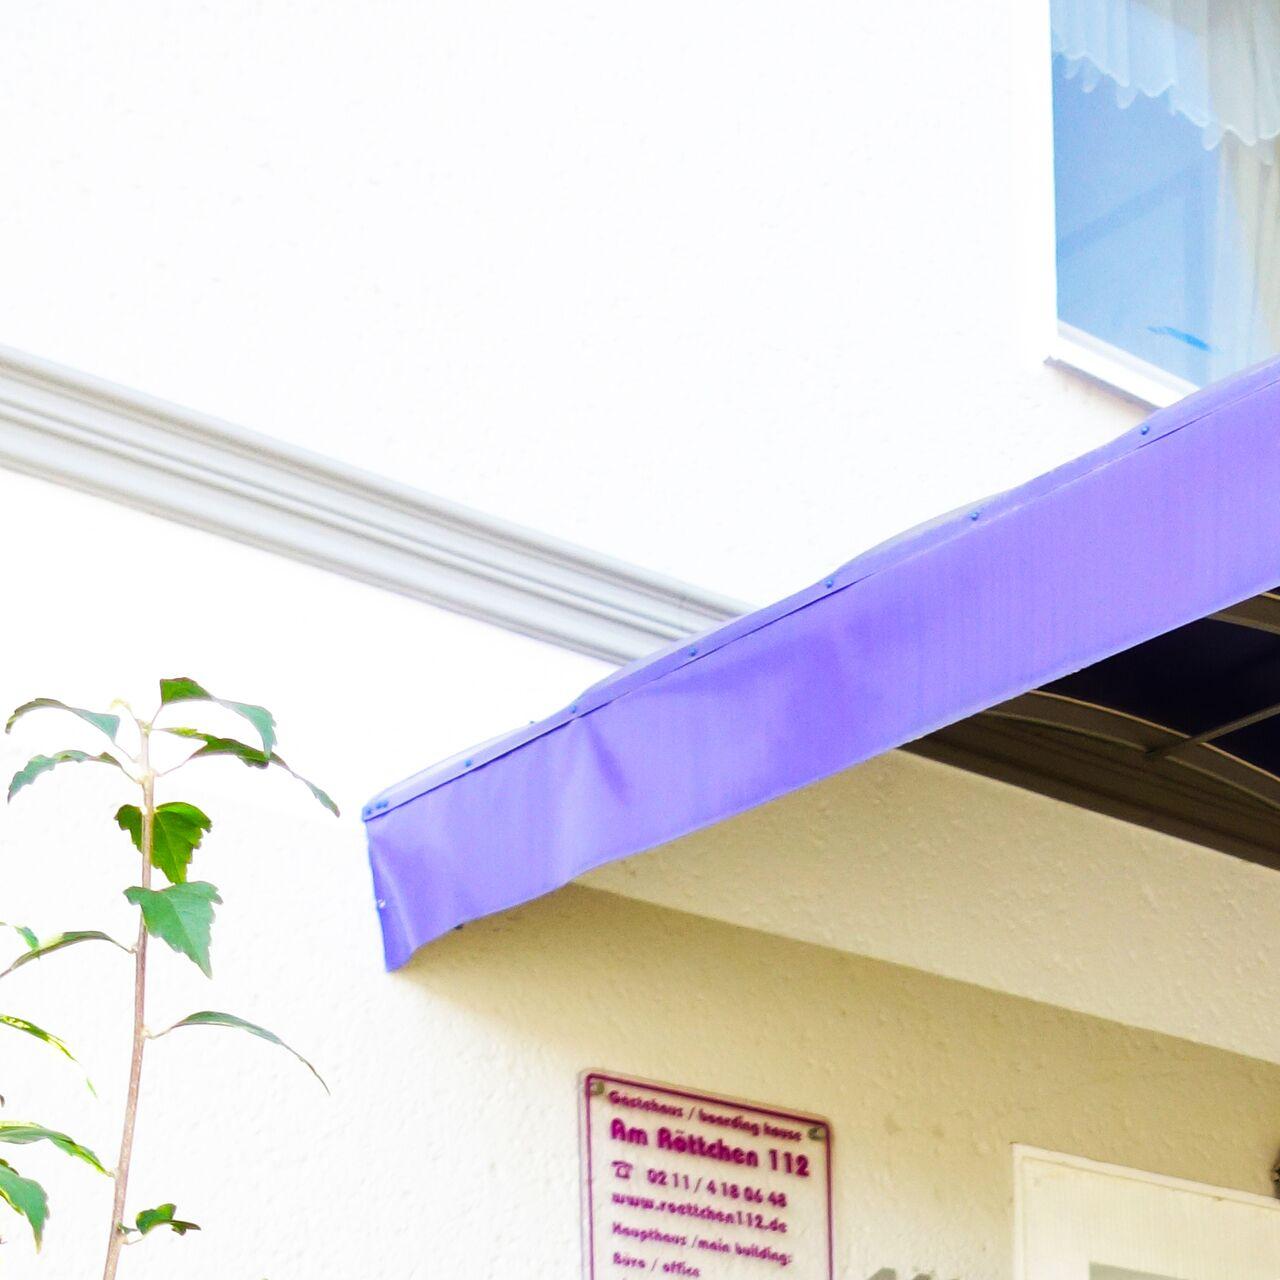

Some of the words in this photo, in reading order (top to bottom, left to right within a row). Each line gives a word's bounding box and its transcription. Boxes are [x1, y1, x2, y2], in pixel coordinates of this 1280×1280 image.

[610, 1117, 648, 1146] Am
[656, 1126, 758, 1168] Röttchen
[768, 1147, 810, 1178] 112
[763, 1122, 802, 1142] house
[612, 1192, 787, 1234] www.roettchen112.de
